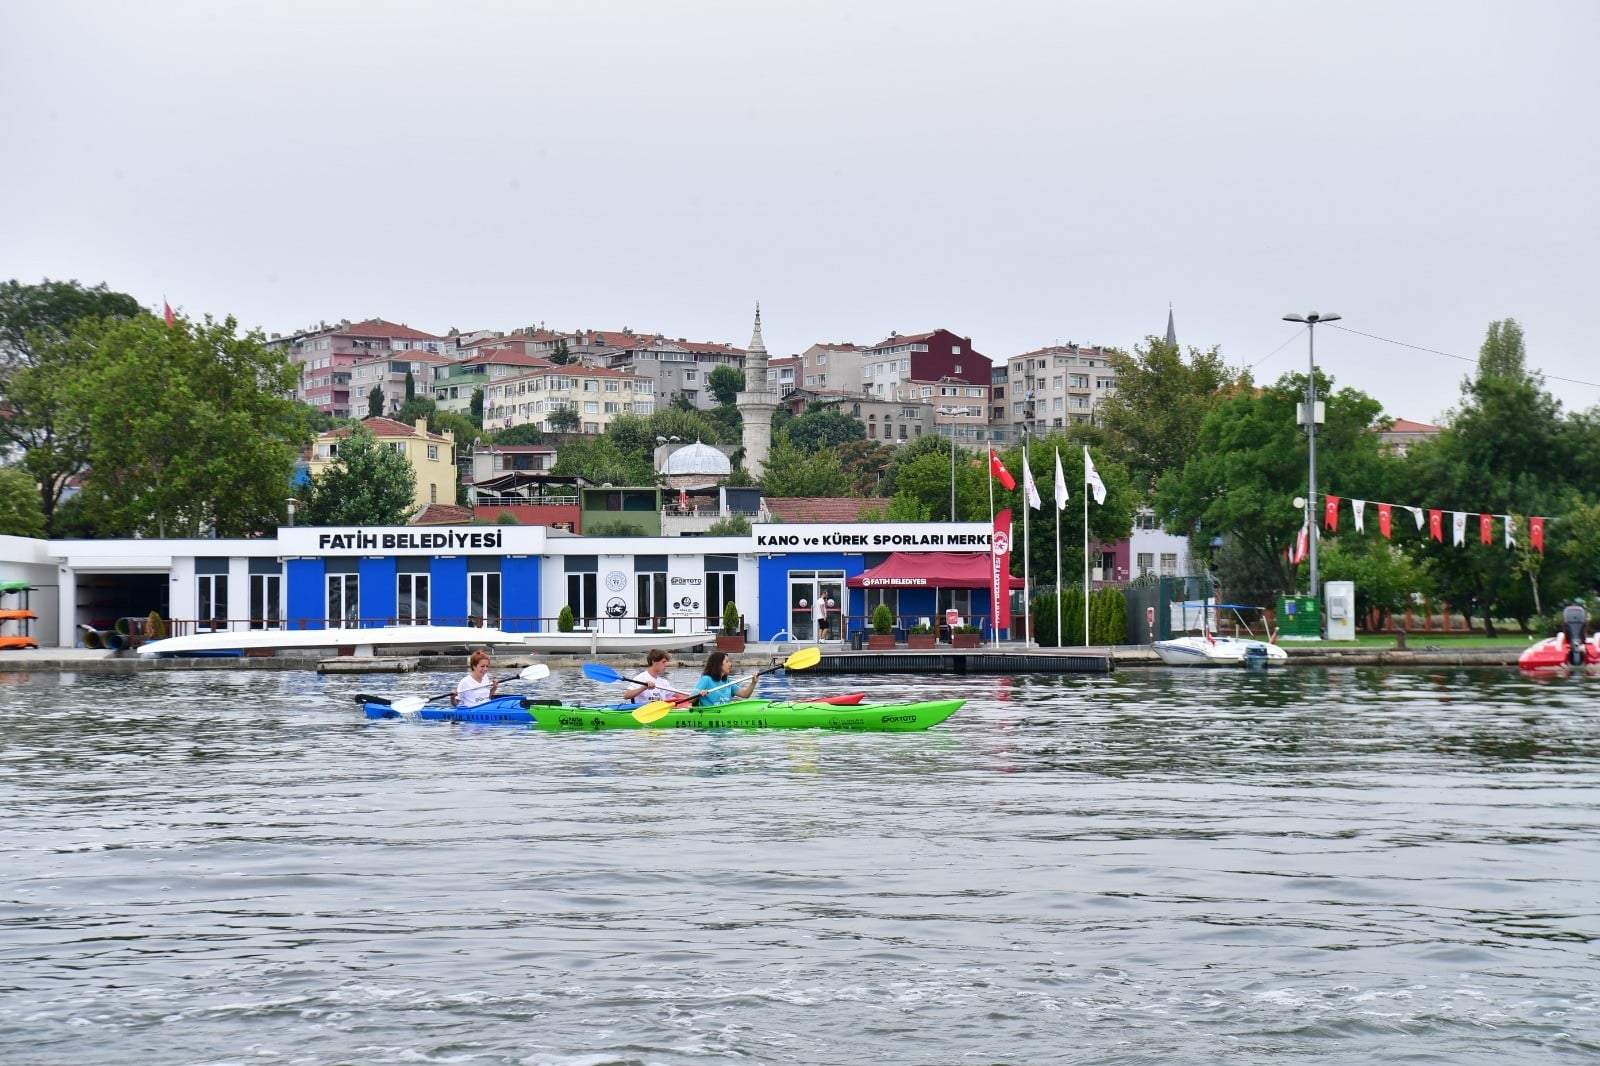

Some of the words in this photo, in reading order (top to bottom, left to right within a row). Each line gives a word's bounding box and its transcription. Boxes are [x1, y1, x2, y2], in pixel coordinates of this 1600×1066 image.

[319, 530, 377, 549] FATİH
[382, 529, 502, 549] BELEDİYESİ
[757, 535, 800, 546] KANO
[803, 537, 819, 546] ve
[822, 532, 869, 546] KÜREK
[873, 534, 943, 546] SPORLARI
[947, 534, 992, 546] MERKE
